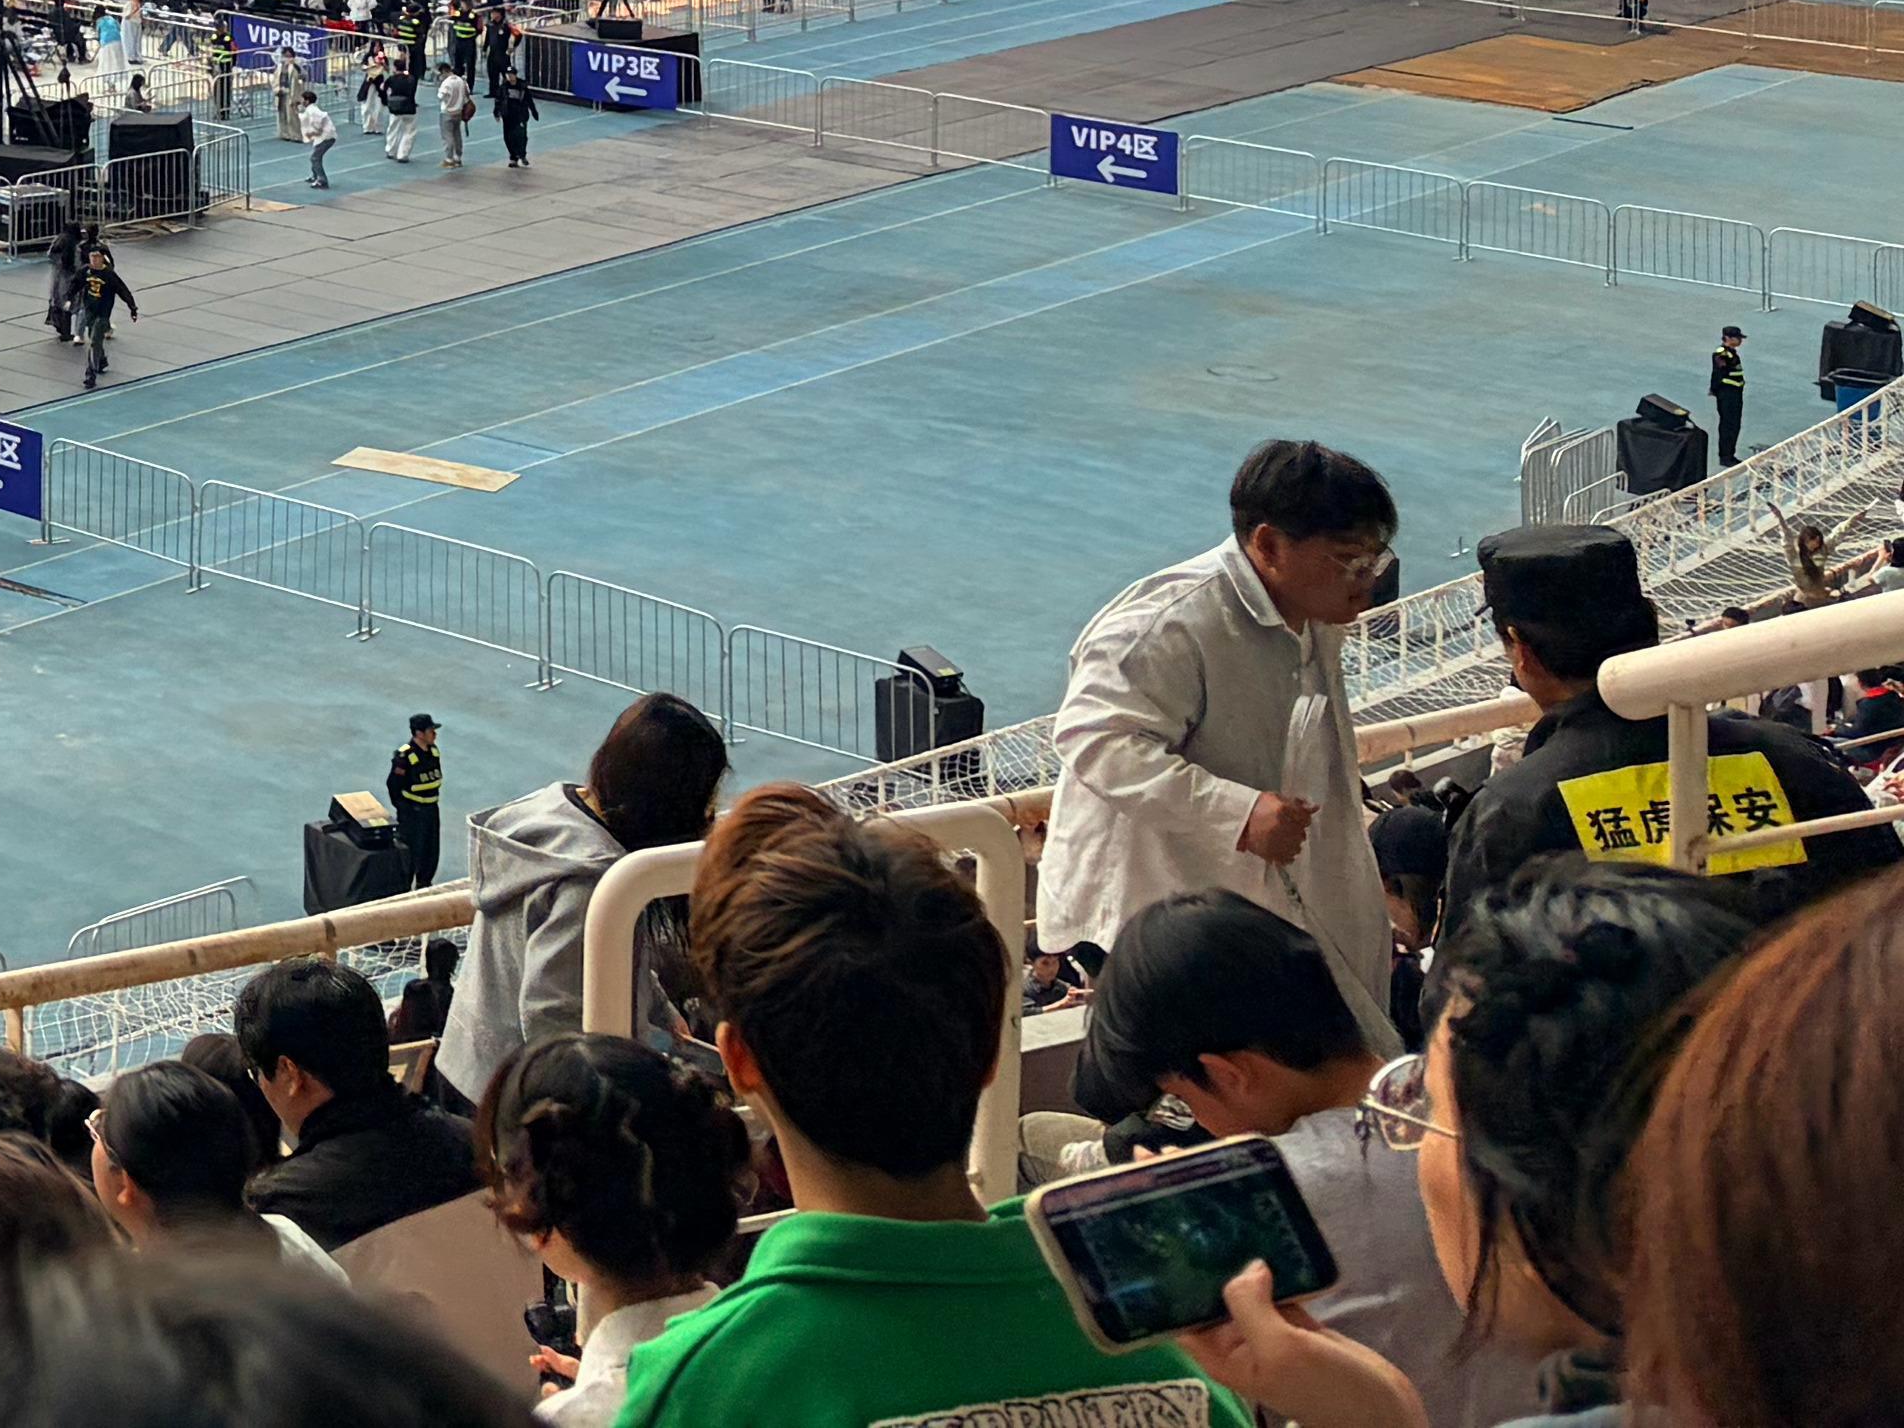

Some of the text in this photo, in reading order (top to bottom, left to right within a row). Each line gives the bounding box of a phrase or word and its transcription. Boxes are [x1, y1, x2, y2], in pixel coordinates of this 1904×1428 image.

[247, 23, 312, 55] VIP8区
[587, 50, 661, 81] VIP3区
[1070, 125, 1159, 162] VIP4区
[1586, 786, 1783, 852] 猛虎保安
